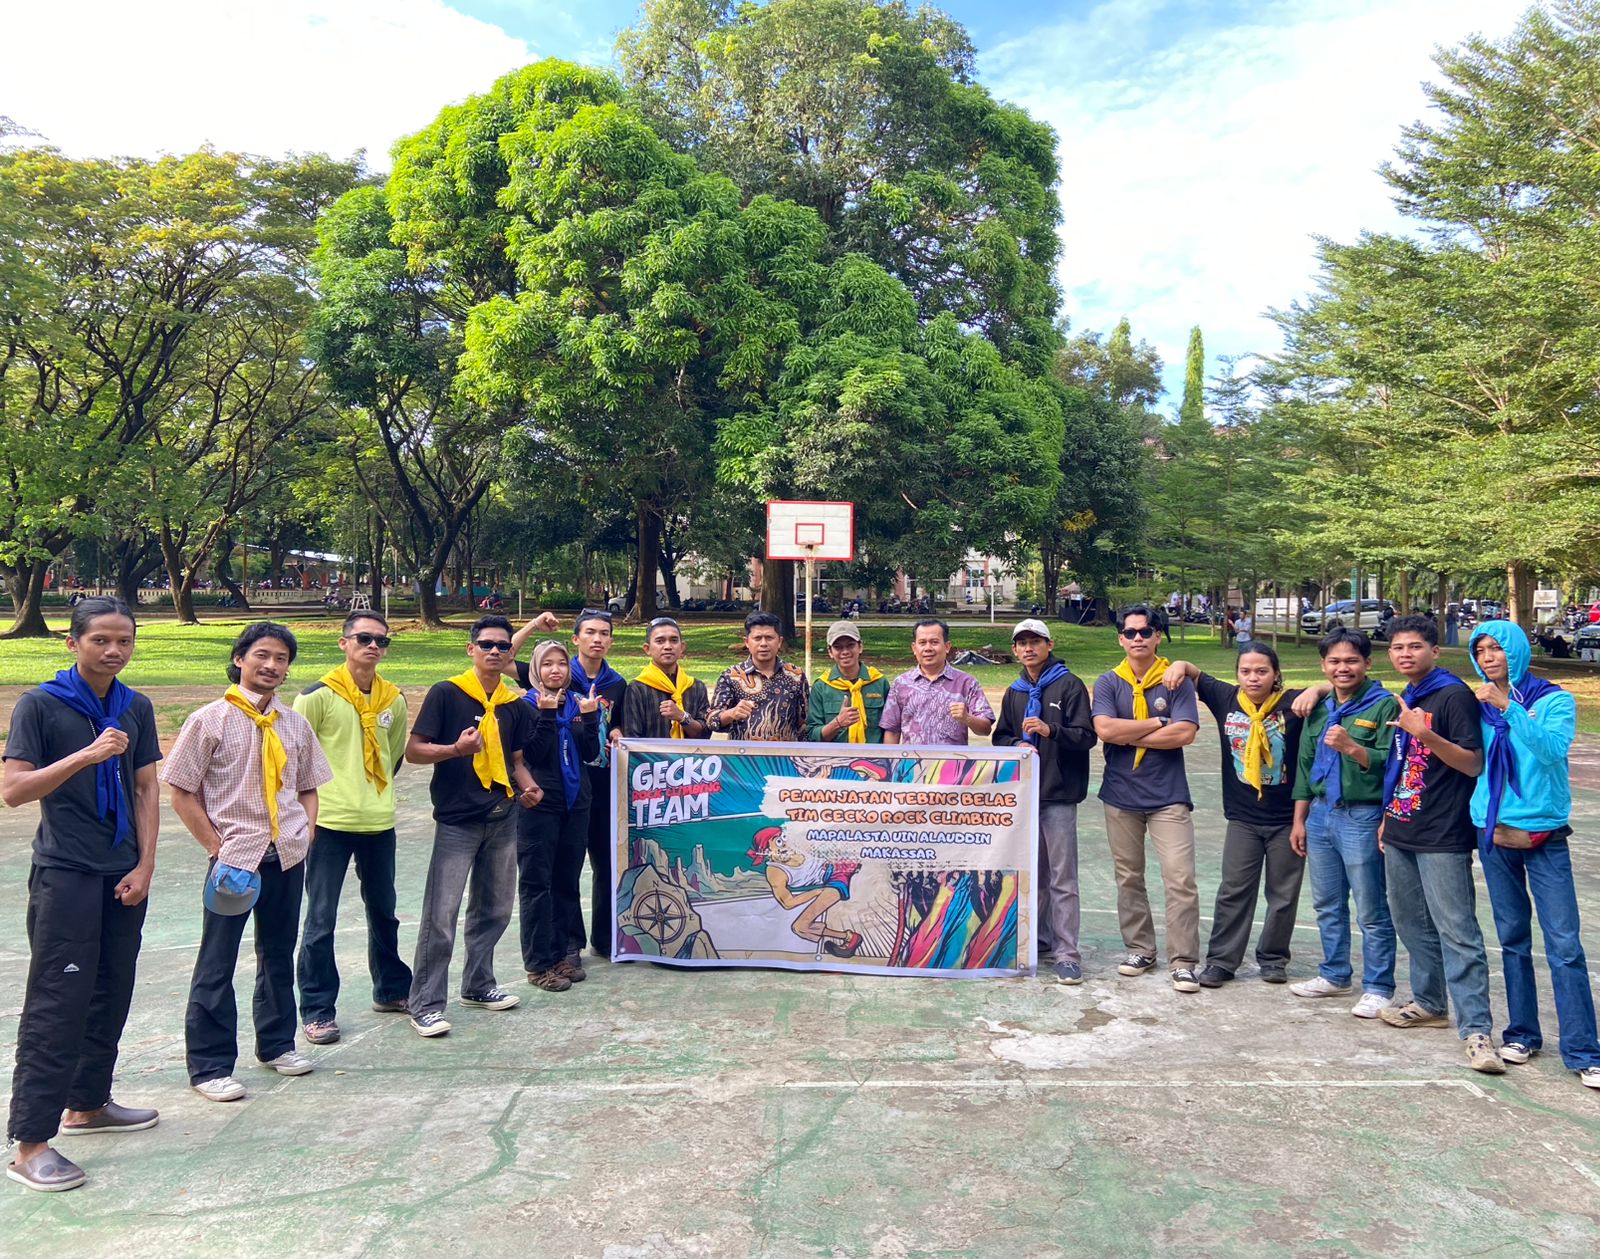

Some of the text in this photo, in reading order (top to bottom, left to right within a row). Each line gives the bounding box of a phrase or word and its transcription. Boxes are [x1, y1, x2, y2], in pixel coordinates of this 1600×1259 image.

[632, 755, 722, 792] GECKO
[632, 781, 721, 801] ROCK CLIMBING
[779, 789, 1016, 806] PEMANJATAN TEBING BELAE
[631, 792, 709, 830] TEAM
[786, 809, 1013, 826] TIM GECKO ROCK CLIMBING
[807, 829, 991, 844] MAPALASTA UIN ALAUDDIN
[860, 847, 936, 859] MAKASSAR
